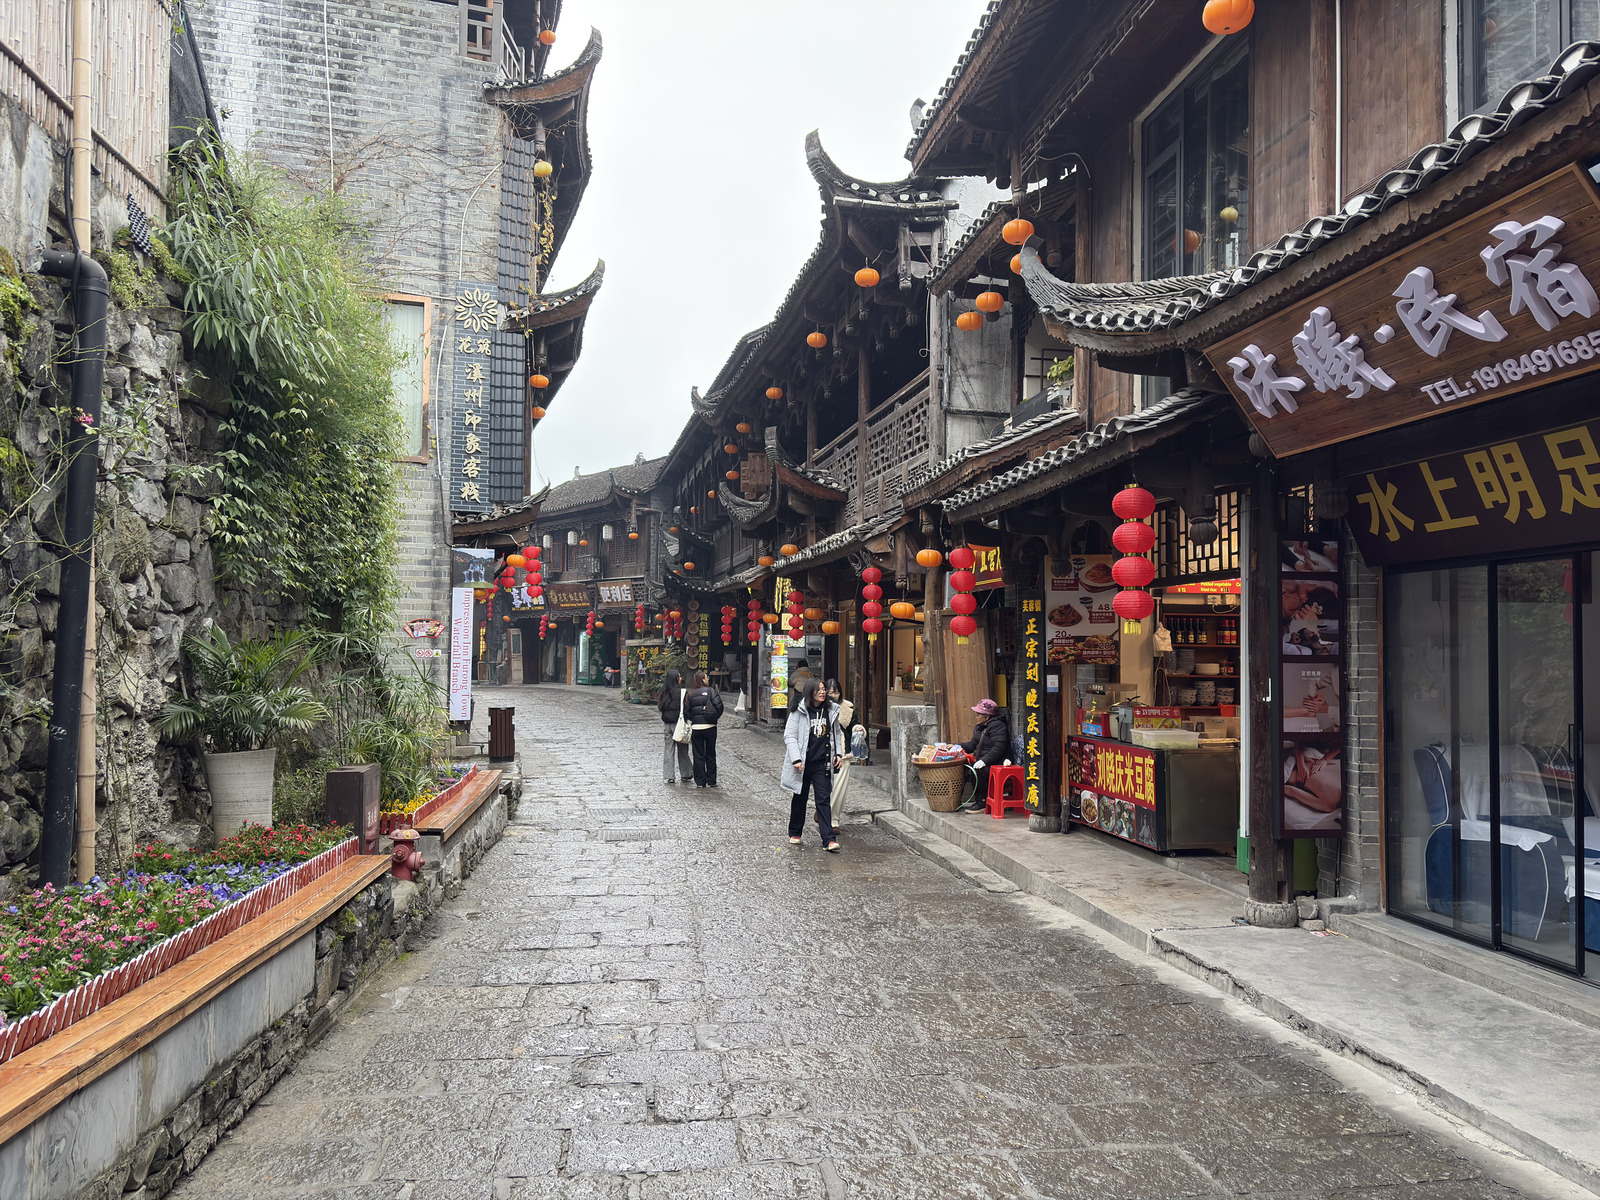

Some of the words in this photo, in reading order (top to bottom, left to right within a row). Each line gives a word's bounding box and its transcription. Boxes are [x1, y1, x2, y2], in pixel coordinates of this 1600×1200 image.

[457, 336, 492, 356] 花筑
[1355, 425, 1600, 543] 水上明足
[599, 584, 632, 603] 便利店
[1098, 603, 1110, 611] 48
[461, 591, 473, 639] Impression
[453, 617, 463, 660] Waterfall
[1055, 630, 1067, 638] 20
[1098, 642, 1110, 650] 28
[462, 641, 472, 657] Inn
[451, 662, 462, 694] Branch
[460, 659, 472, 690] Furong
[461, 693, 471, 719] Town
[1024, 617, 1041, 808] 正宗刘晓庆米豆腐
[1097, 747, 1155, 806] 刘晓庆米豆腐
